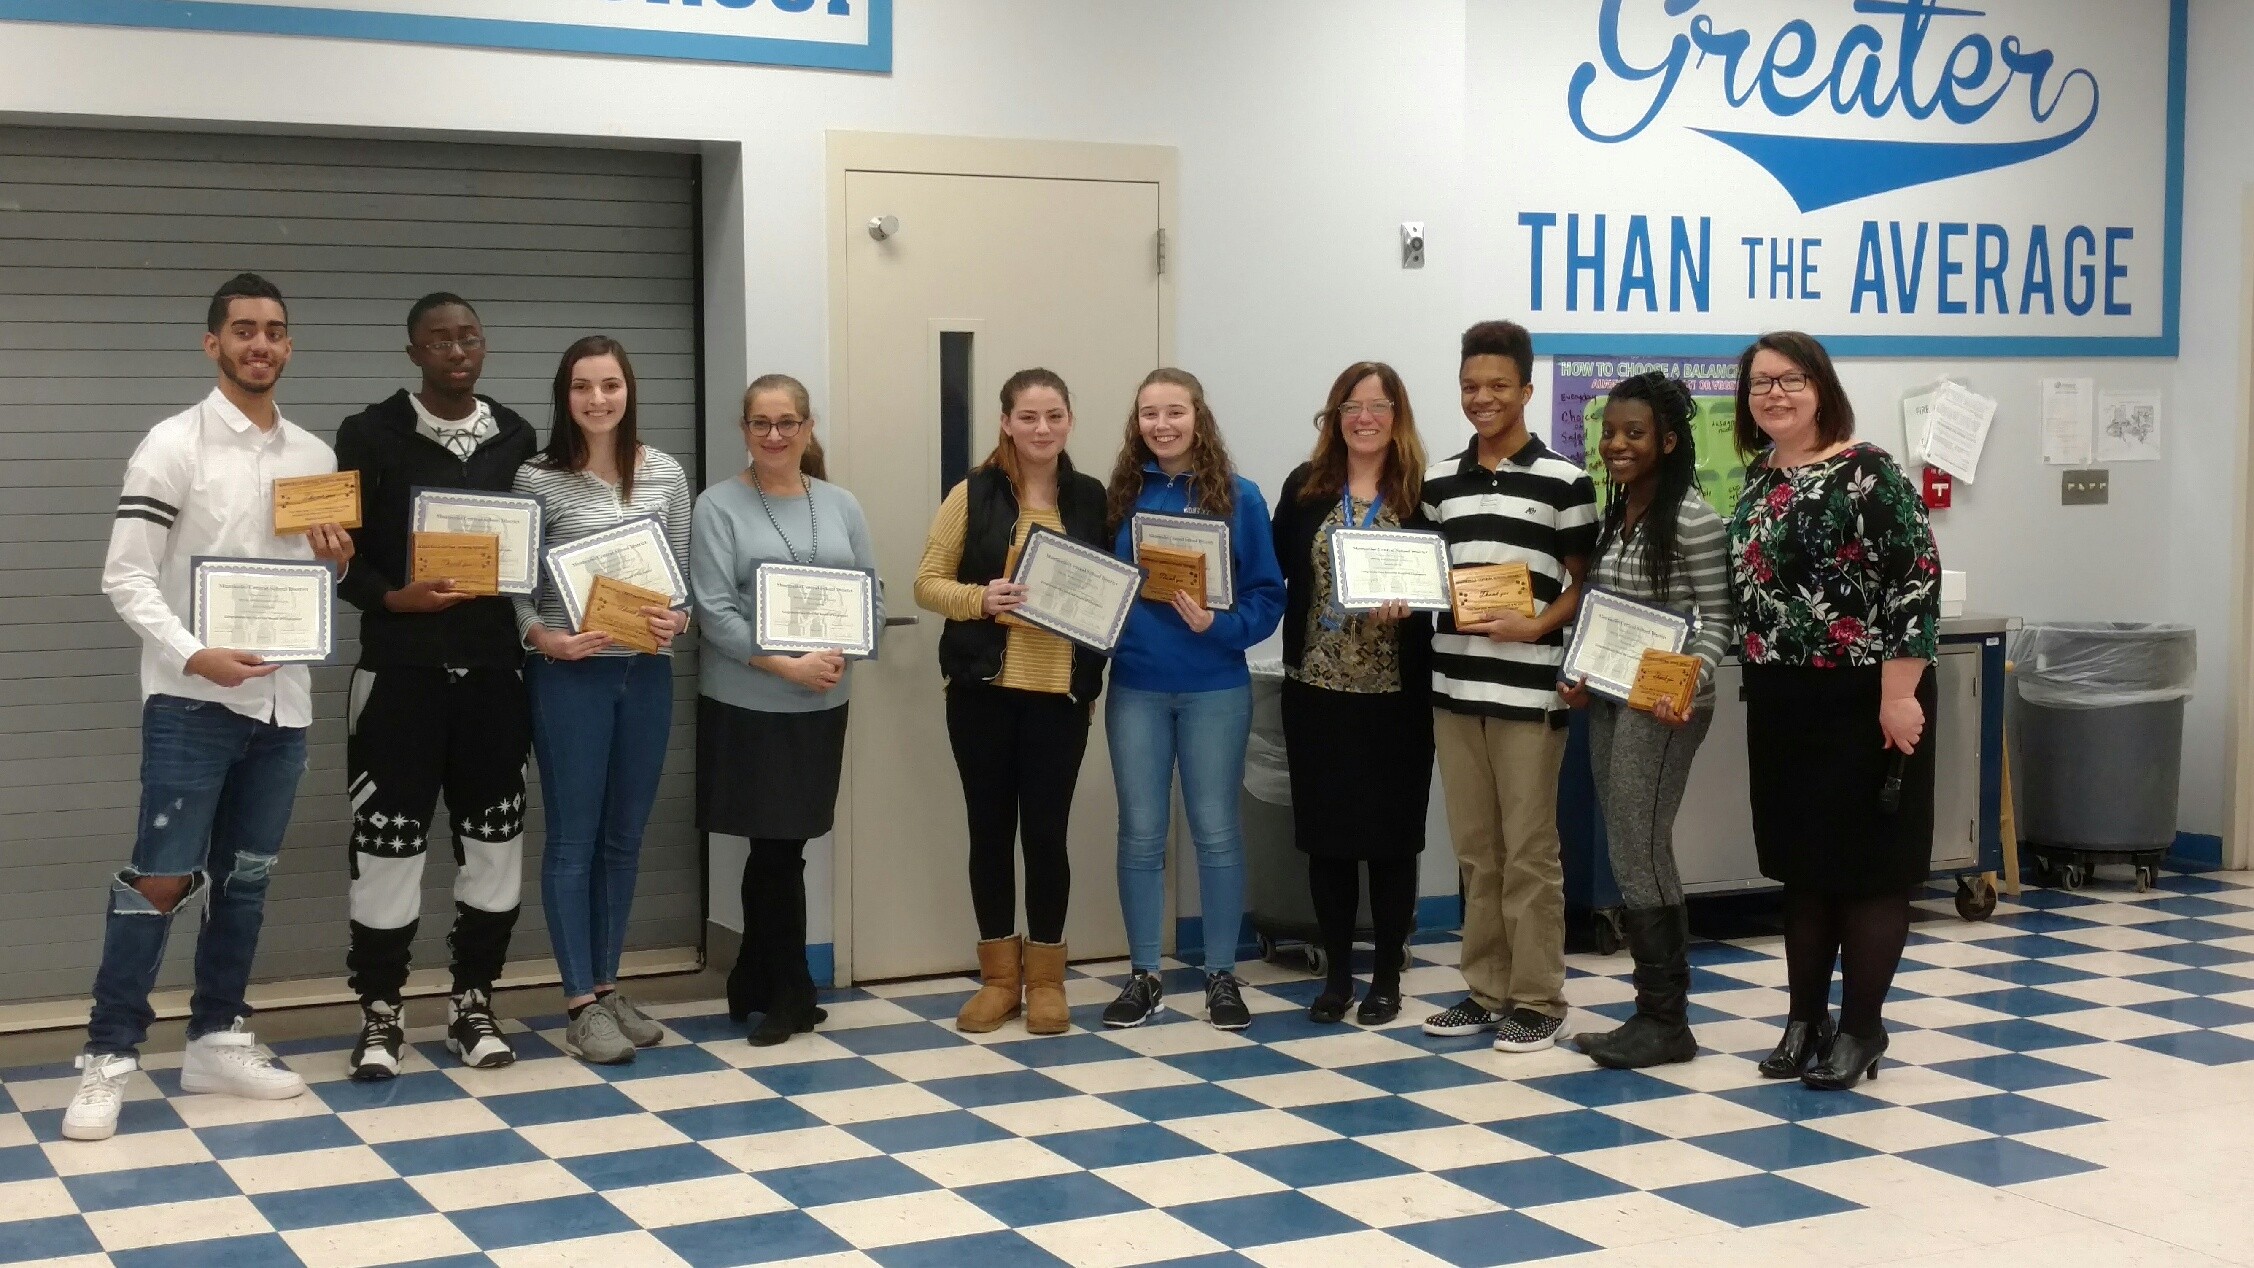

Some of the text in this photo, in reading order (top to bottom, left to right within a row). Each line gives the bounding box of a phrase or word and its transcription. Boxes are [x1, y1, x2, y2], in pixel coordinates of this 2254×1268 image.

[1568, 0, 2099, 143] Greater
[1518, 212, 2134, 316] THAN THE AVERAGE
[1560, 361, 1594, 377] HOW
[1596, 362, 1614, 377] TO
[1670, 363, 1680, 378] A
[1683, 363, 1740, 379] BALANC
[1561, 409, 1599, 421] Choice
